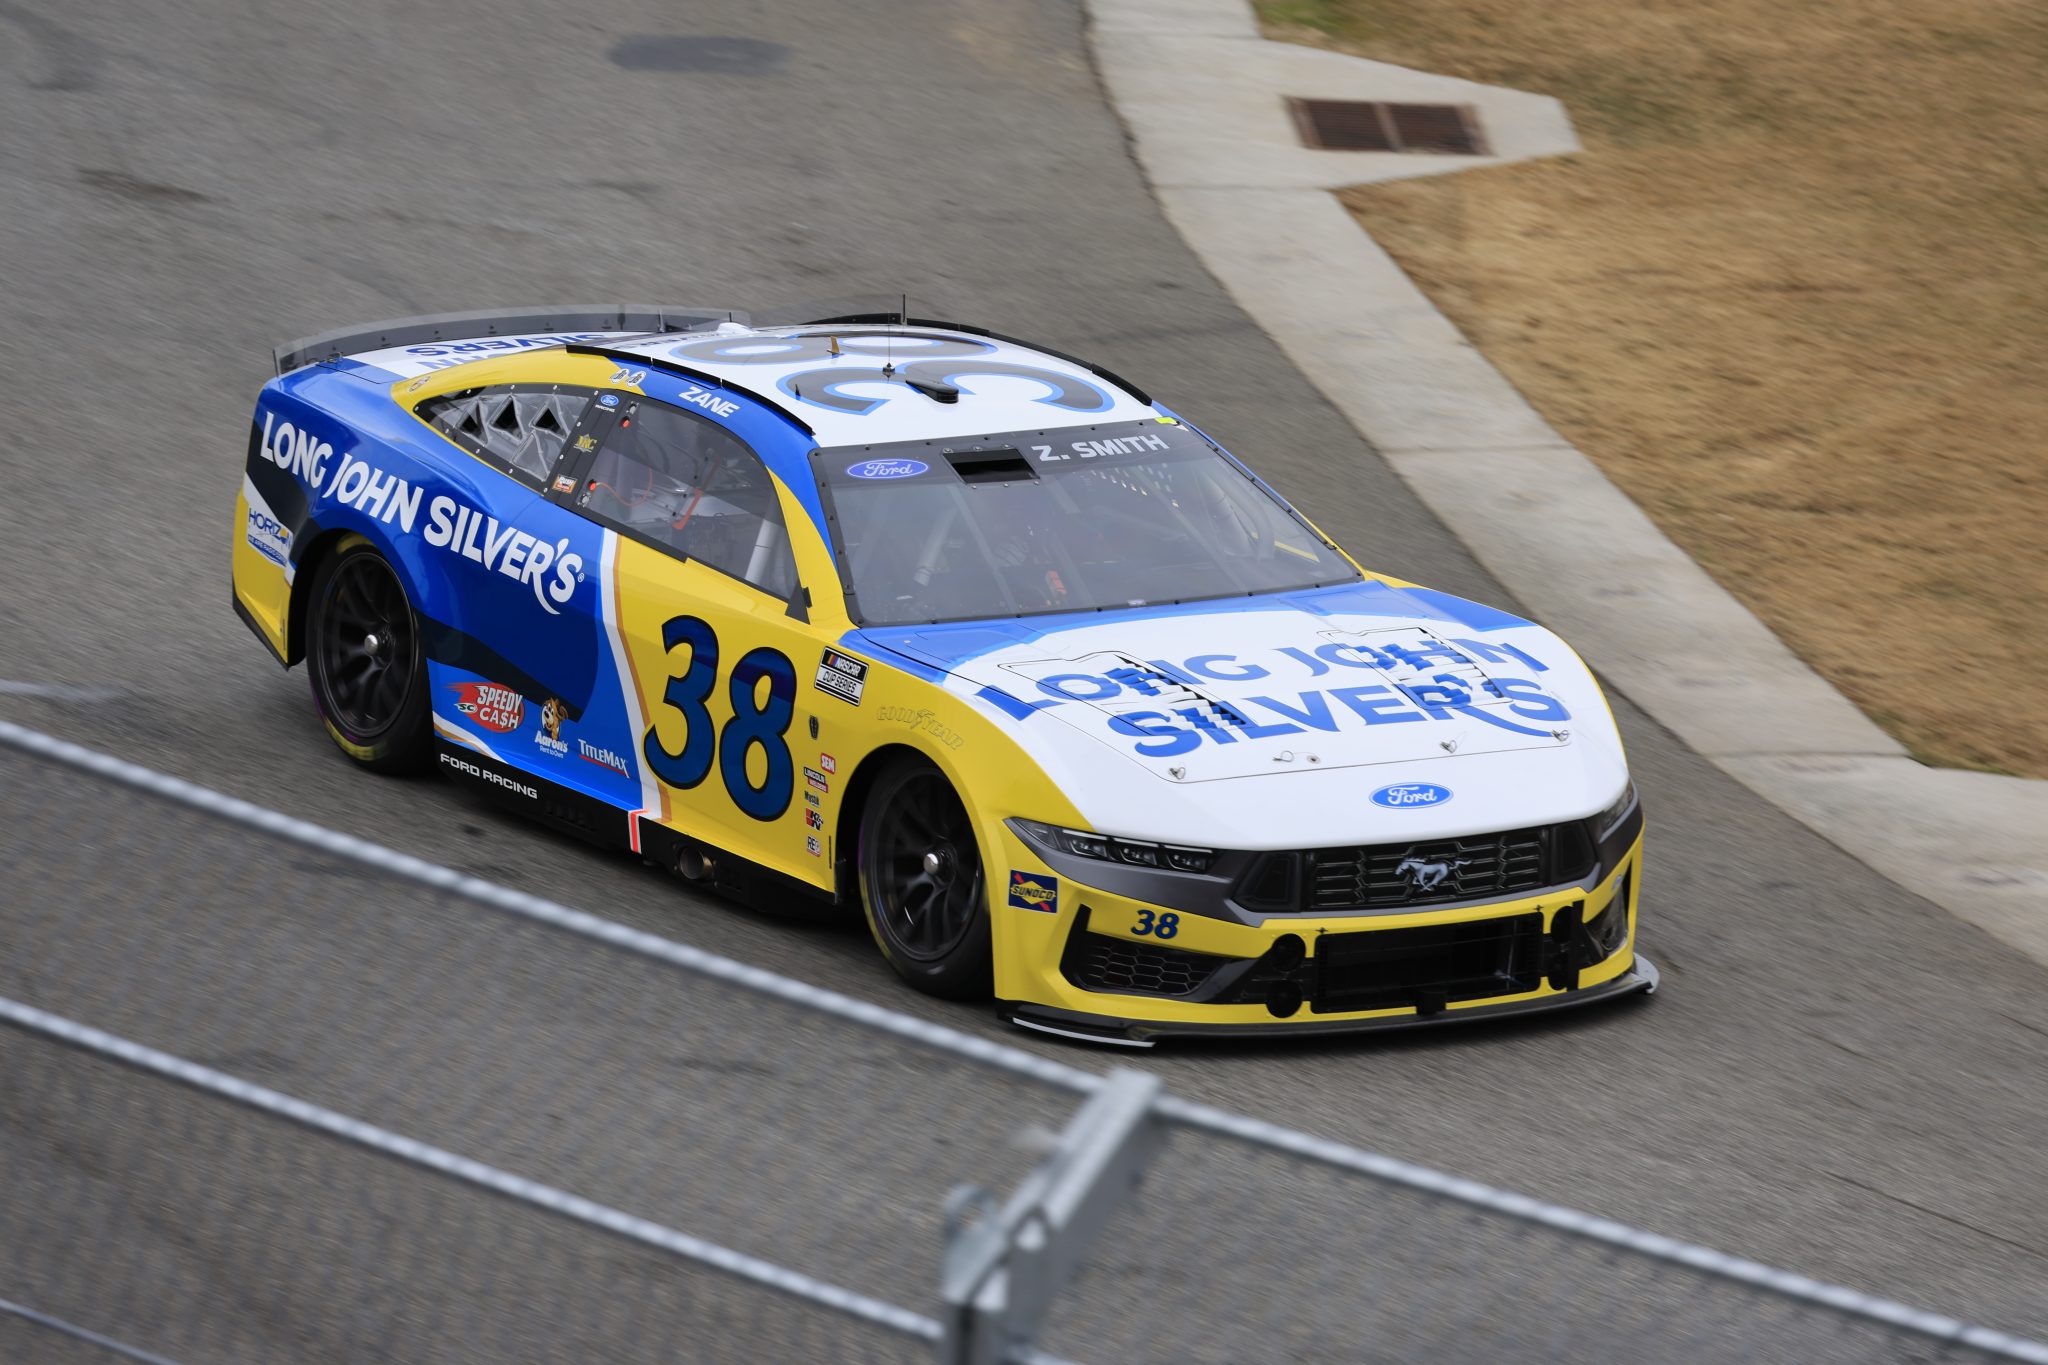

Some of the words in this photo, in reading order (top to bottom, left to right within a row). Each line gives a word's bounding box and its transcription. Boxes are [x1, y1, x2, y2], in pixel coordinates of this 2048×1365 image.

[679, 387, 740, 417] ZANE
[1031, 445, 1071, 461] Z.
[1072, 434, 1170, 458] SMITH
[863, 460, 913, 477] Ford
[260, 412, 334, 488] LONG
[323, 454, 424, 533] JOHN
[424, 495, 584, 615] SILVER'S
[834, 657, 861, 677] NASCAR
[974, 654, 1271, 721] LONG
[1272, 641, 1549, 677] JOHN
[822, 670, 835, 685] CUP
[834, 675, 857, 693] SERIES
[474, 685, 523, 713] SPEEDY
[644, 615, 797, 822] 38
[440, 753, 480, 777] FORD
[482, 769, 538, 799] RACING
[1387, 785, 1438, 805] Ford
[1011, 884, 1055, 901] SUNOCO
[1130, 909, 1180, 940] 38
